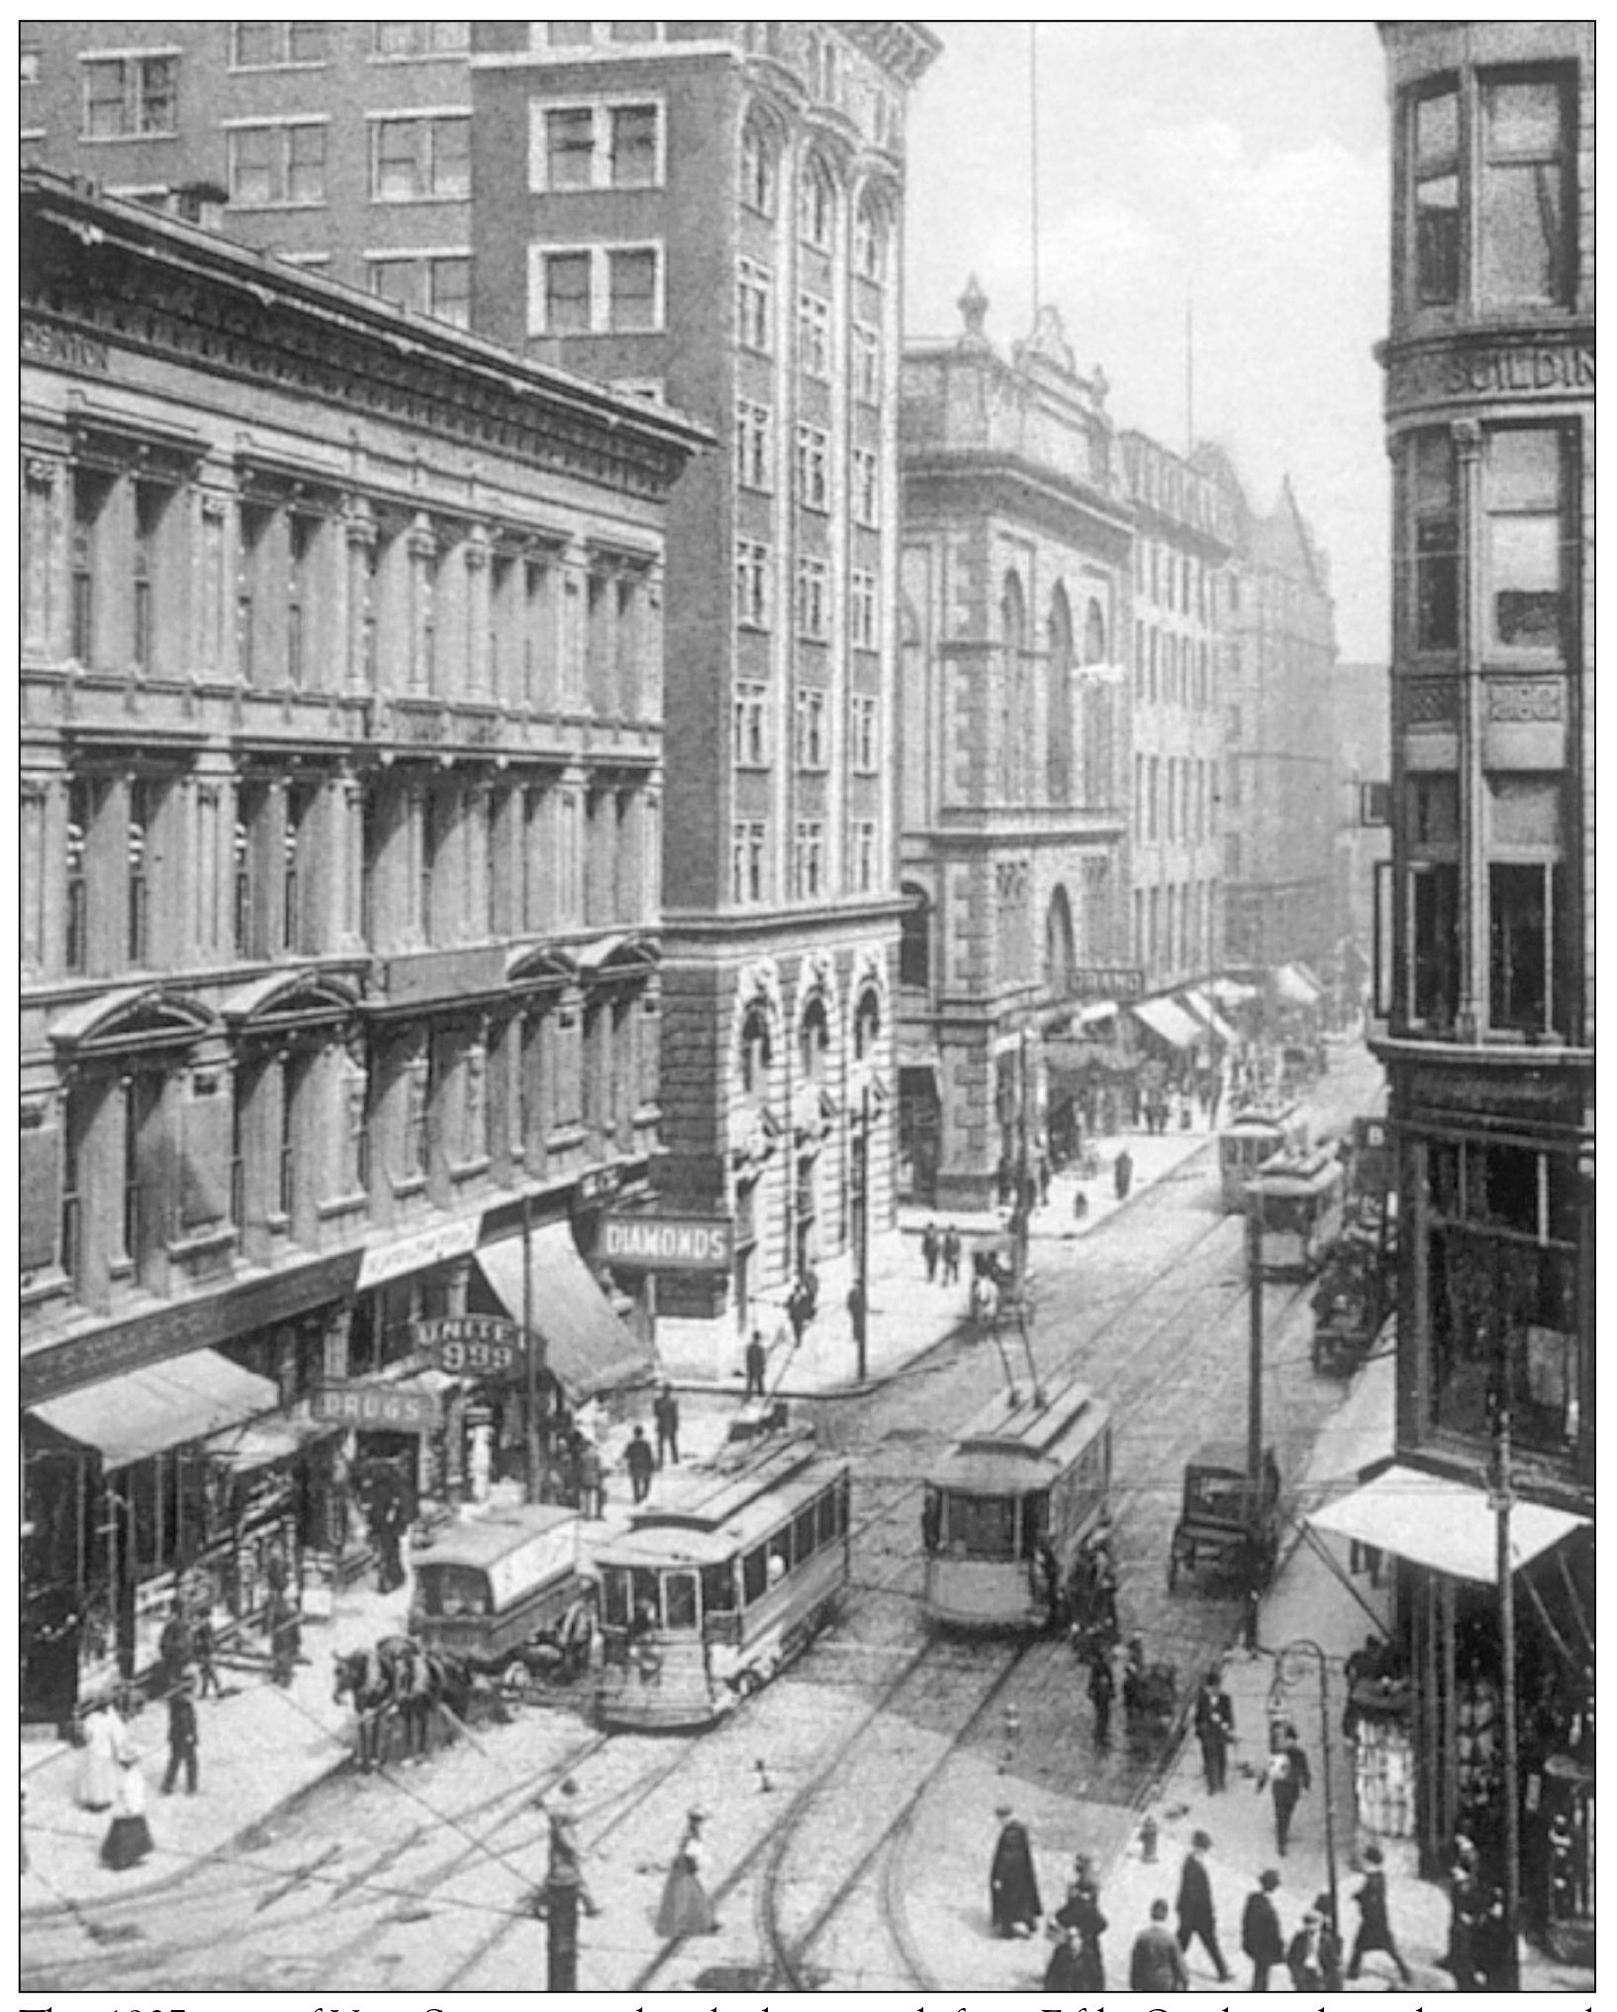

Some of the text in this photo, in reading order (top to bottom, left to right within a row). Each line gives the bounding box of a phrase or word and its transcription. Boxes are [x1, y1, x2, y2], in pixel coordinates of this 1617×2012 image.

[605, 1225, 729, 1261] DIAMONDS
[442, 1341, 513, 1370] 999
[323, 1392, 421, 1421] DRUGS
